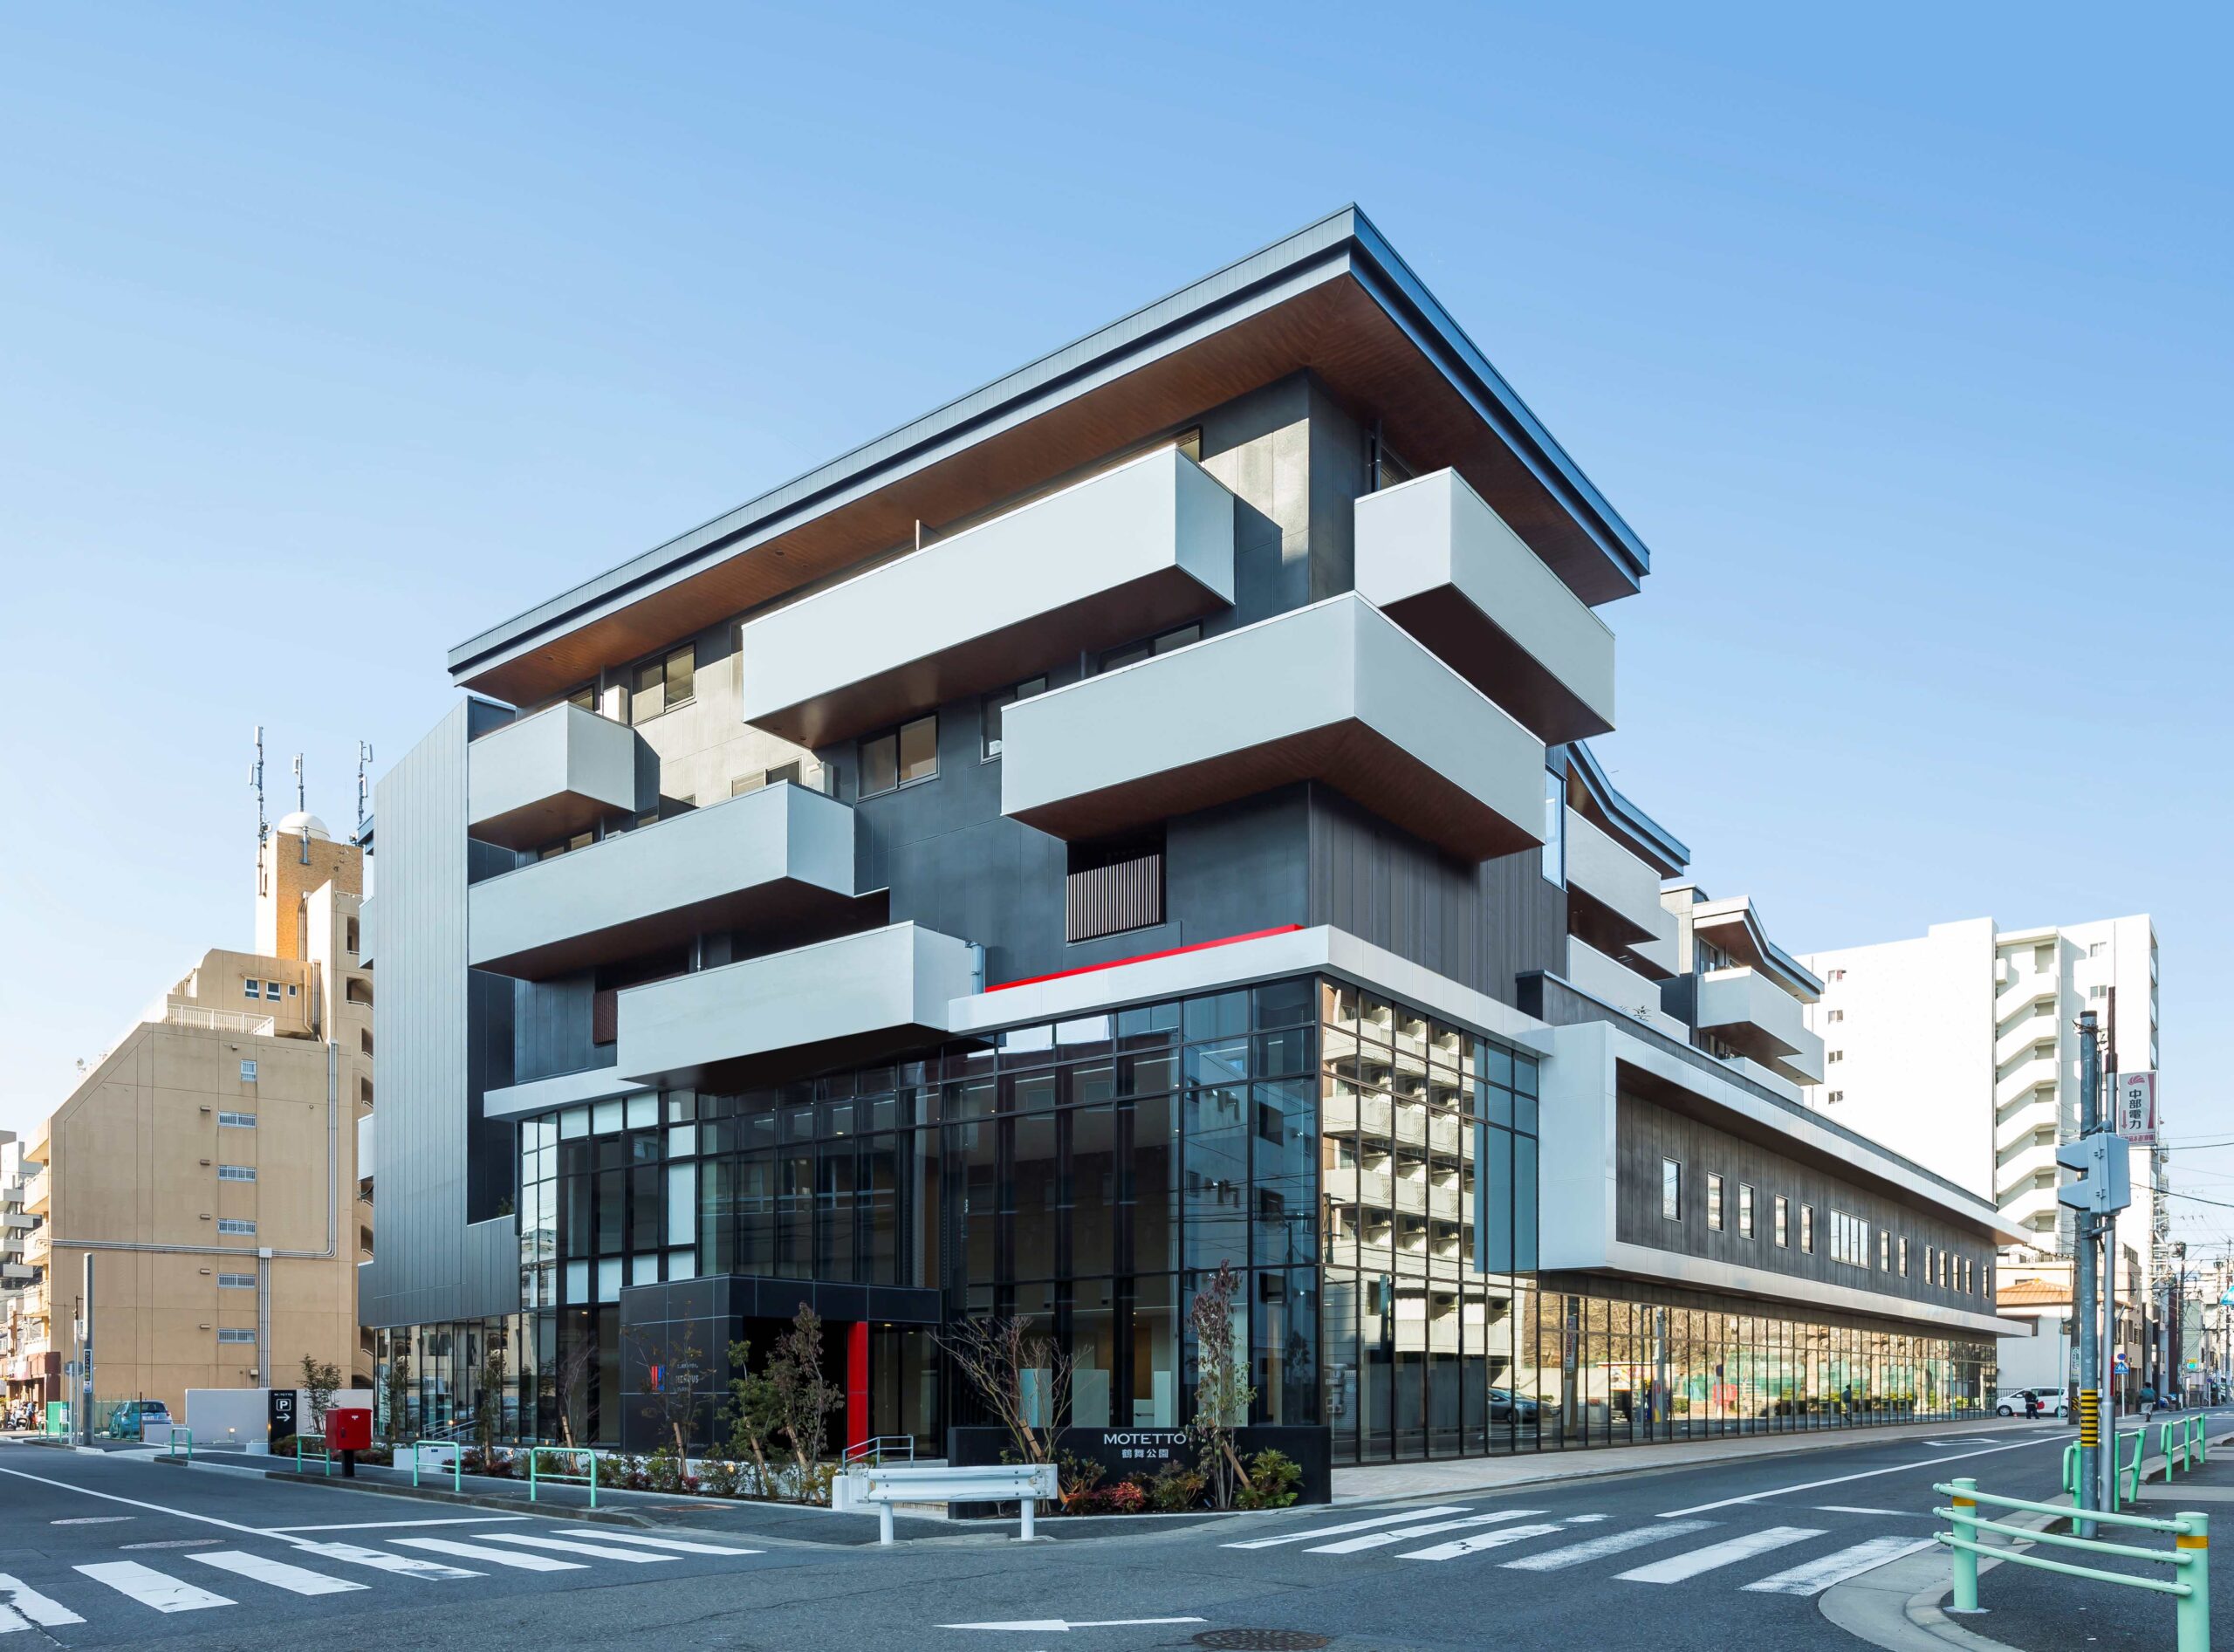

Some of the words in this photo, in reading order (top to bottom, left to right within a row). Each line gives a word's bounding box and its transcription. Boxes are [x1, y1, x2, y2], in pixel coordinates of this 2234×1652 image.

[2128, 1088, 2142, 1130] 中部電力
[279, 1400, 288, 1409] P
[1103, 1433, 1187, 1445] MOTETTO
[1121, 1449, 1169, 1458] 鶴舞公園
